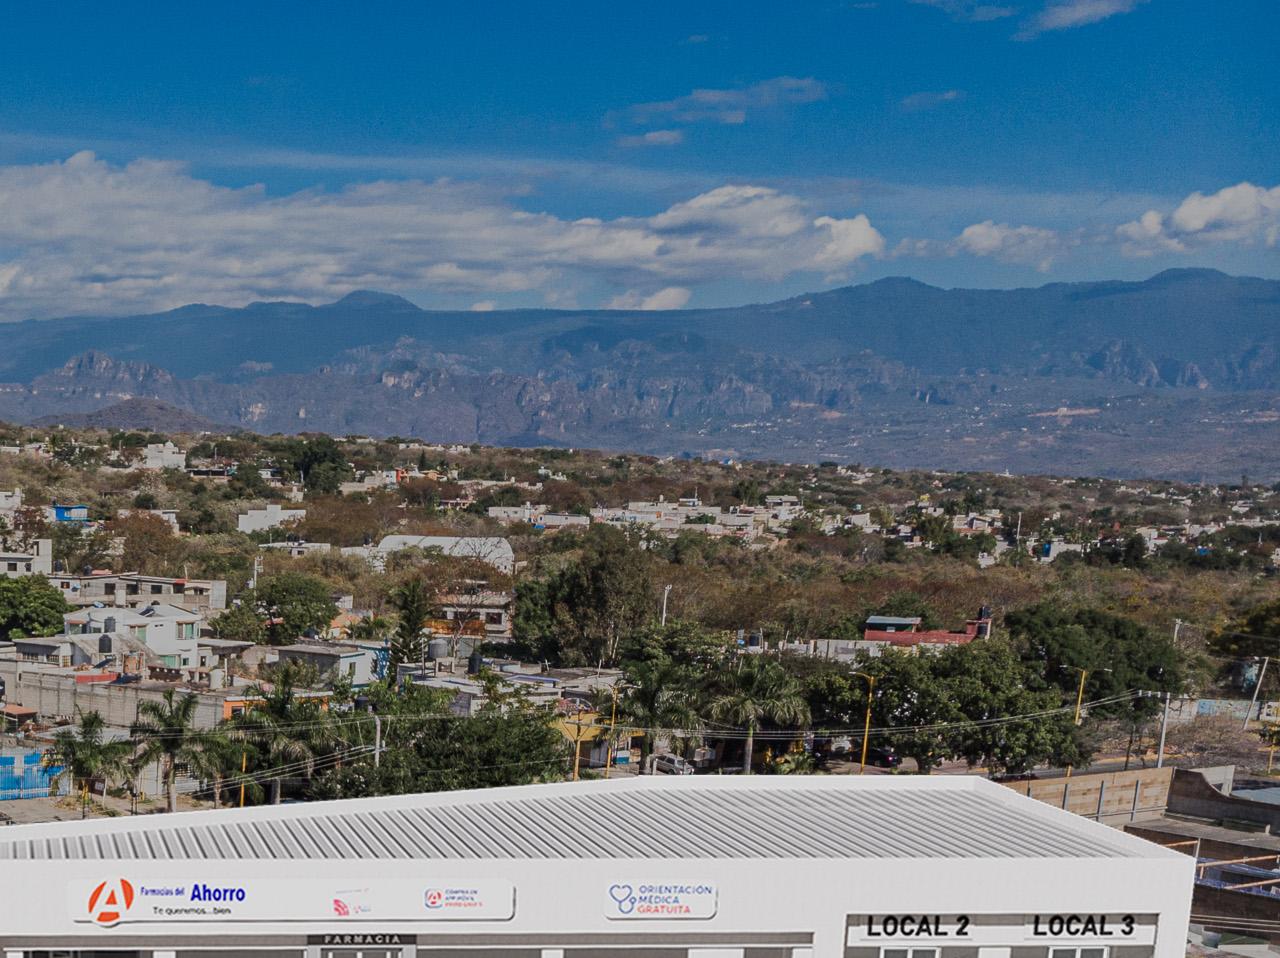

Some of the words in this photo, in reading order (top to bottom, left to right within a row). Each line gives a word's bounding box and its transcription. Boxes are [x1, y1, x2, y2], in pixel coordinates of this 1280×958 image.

[190, 884, 246, 901] Ahorro
[638, 884, 713, 895] ORIENTACIÓN
[153, 906, 163, 915] Te
[637, 905, 691, 914] GRATUITA
[866, 915, 949, 937] LOCAL
[956, 915, 970, 936] 2
[1032, 914, 1114, 936] LOCAL
[1121, 915, 1135, 935] 3
[324, 934, 401, 944] FARMACIA
